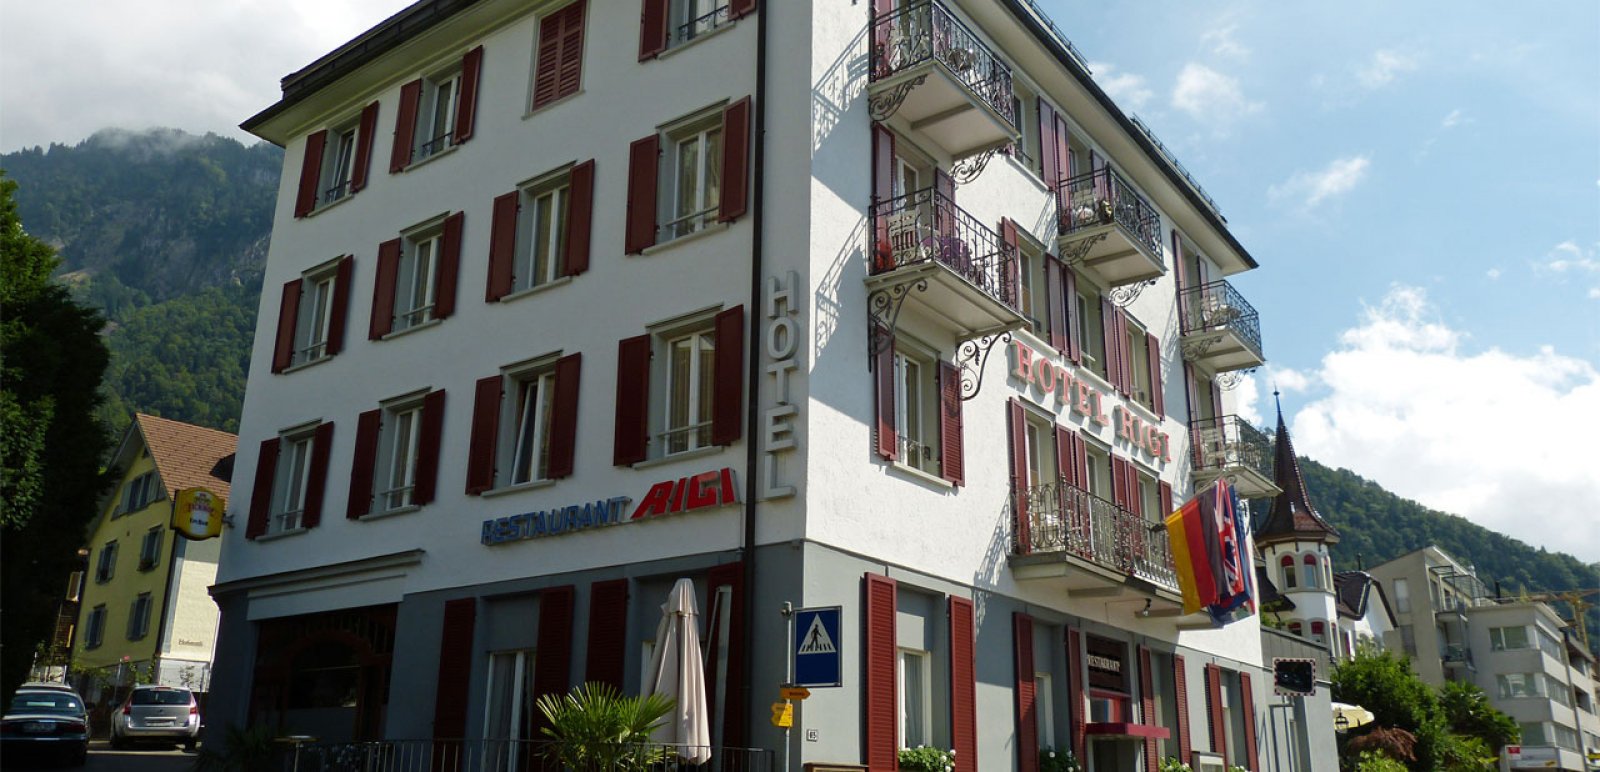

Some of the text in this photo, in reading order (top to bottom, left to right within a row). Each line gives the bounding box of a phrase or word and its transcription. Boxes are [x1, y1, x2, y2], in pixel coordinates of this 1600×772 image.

[766, 270, 798, 498] HOTEL
[1012, 339, 1172, 464] HOTEL RIGI
[480, 467, 738, 546] RESTAURANT RIGI
